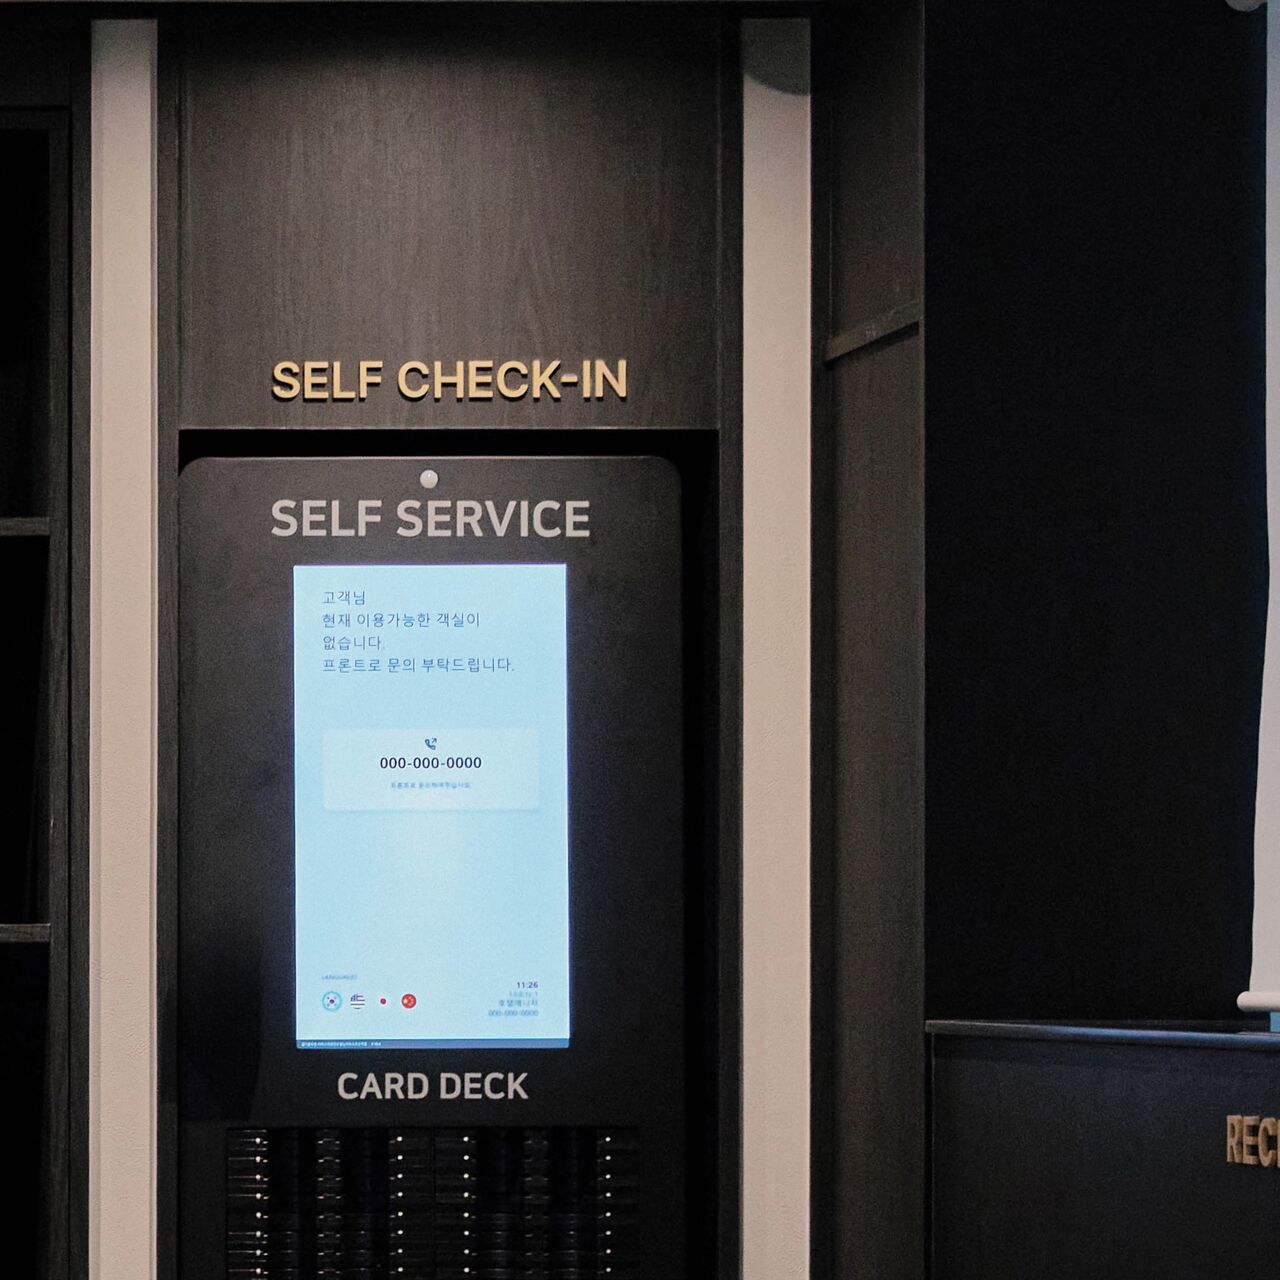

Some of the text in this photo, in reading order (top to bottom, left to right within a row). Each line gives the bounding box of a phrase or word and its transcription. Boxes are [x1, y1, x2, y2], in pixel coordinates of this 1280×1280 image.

[272, 358, 627, 400] SELF CHECK-IN
[270, 499, 591, 537] SELF SERVICE
[322, 590, 366, 606] 고객님
[322, 612, 480, 629] 현재 이용가능한 객실이
[322, 658, 382, 673] 프론트로
[387, 657, 416, 673] 문의
[380, 756, 482, 769] 000-000-0000
[337, 1072, 529, 1100] CARD DECK
